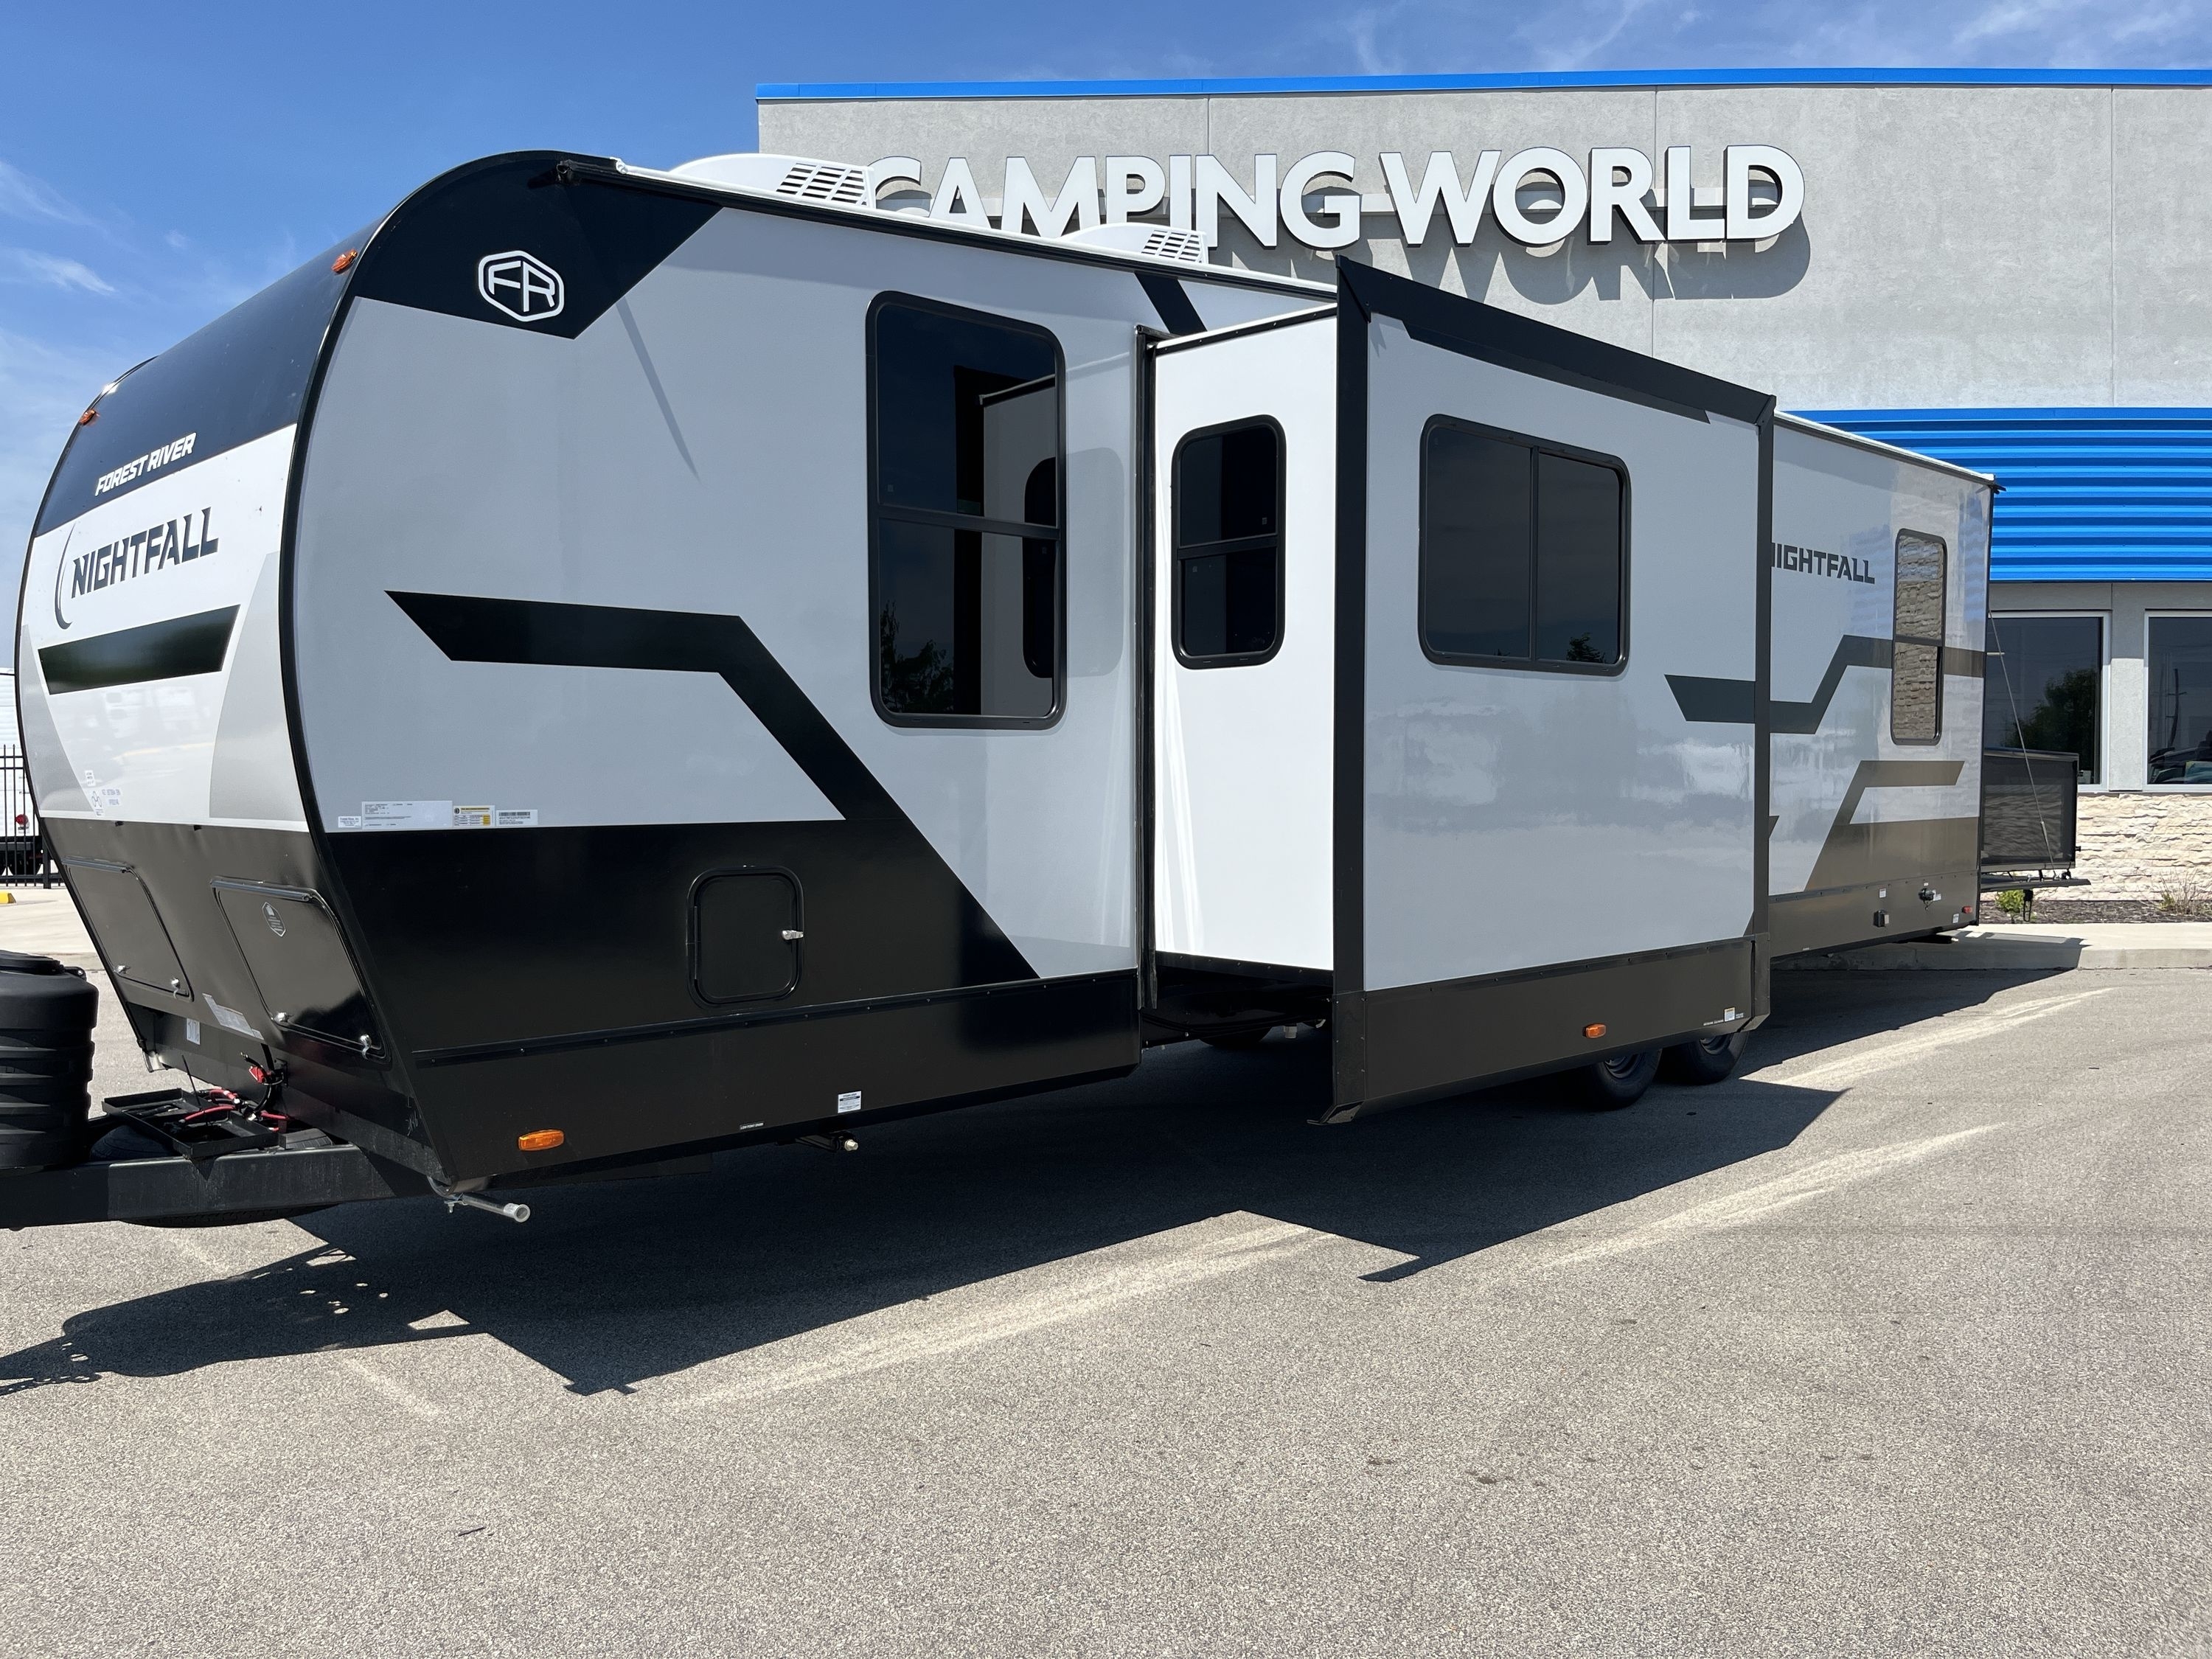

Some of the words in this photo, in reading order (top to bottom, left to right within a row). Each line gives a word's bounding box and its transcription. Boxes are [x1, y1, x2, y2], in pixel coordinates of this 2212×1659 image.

[867, 151, 1362, 249] CAMPING
[1378, 145, 1806, 246] WORLD
[94, 454, 149, 497] FOREST
[147, 432, 197, 473] RIVER
[71, 506, 220, 599] NIGHTFALL
